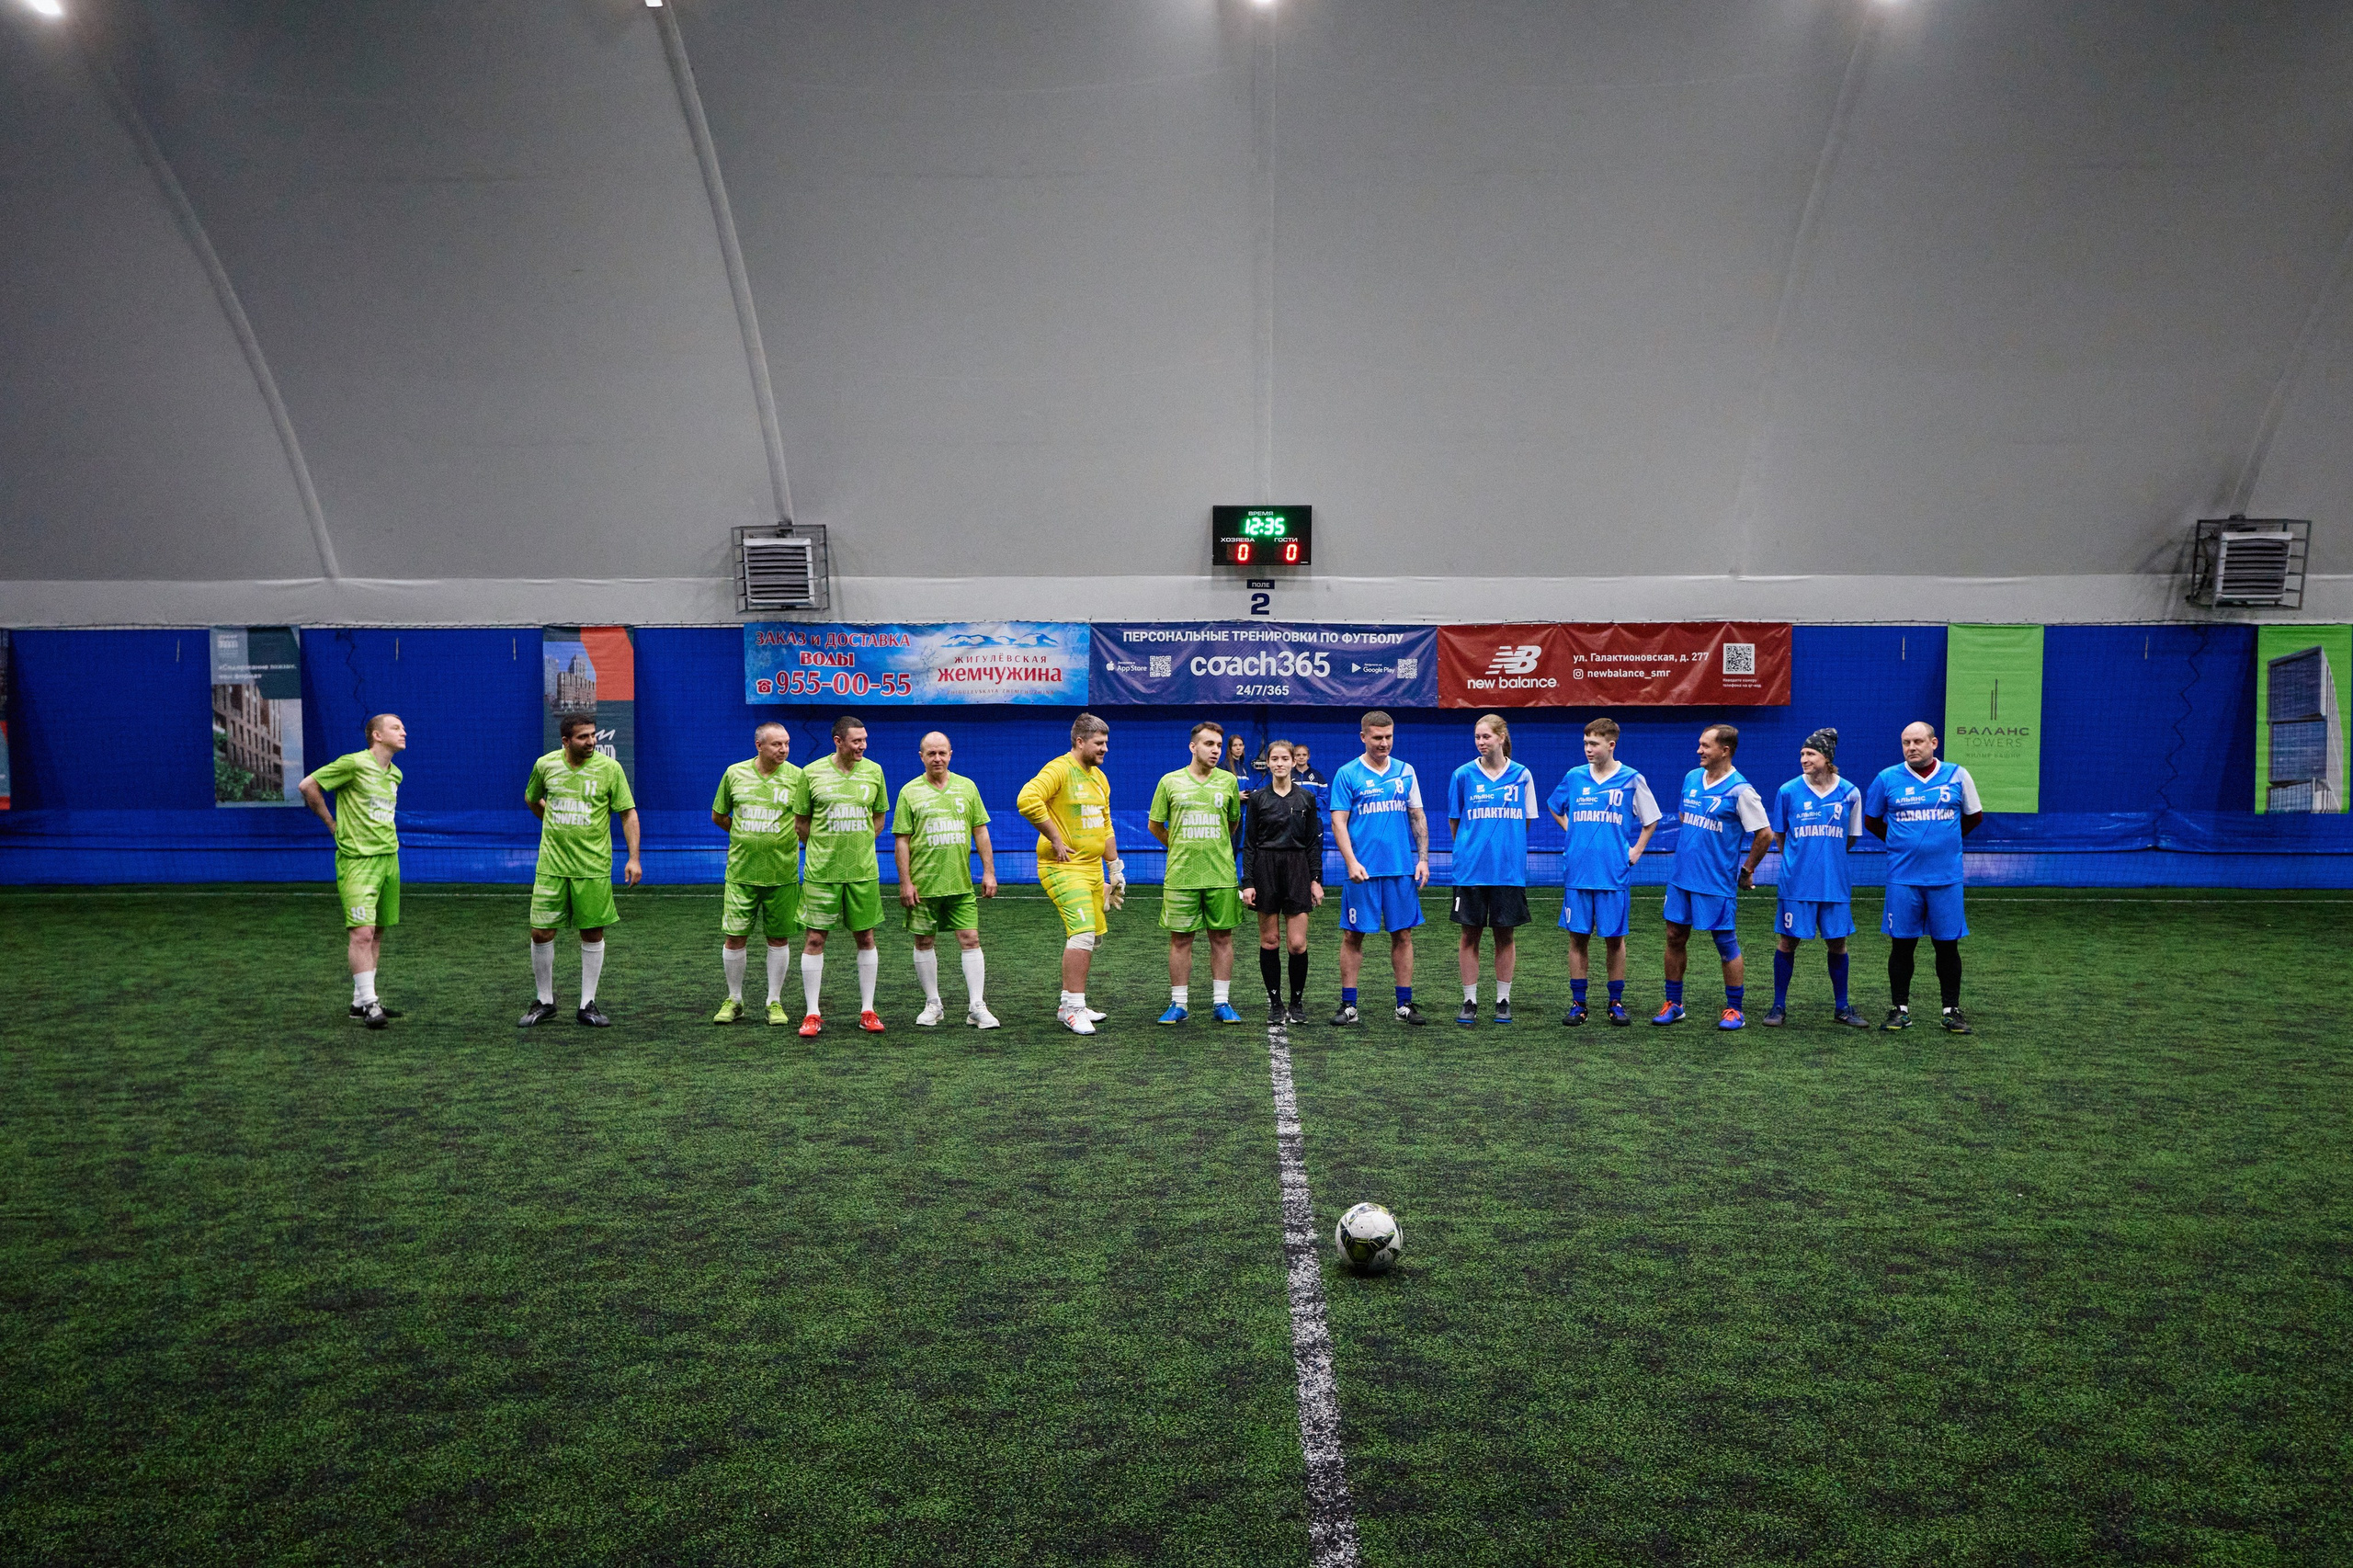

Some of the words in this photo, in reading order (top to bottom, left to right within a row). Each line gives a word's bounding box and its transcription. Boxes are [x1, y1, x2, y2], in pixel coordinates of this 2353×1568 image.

[1245, 517, 1286, 535] 12:35
[1237, 543, 1249, 562] 0
[1286, 543, 1297, 562] 0
[1250, 592, 1270, 616] 2
[756, 631, 807, 646] ЗАКАЗ
[824, 632, 911, 649] ДОСТАВКА
[1123, 631, 1229, 642] ПЕРСОНАЛЬНЫЕ
[1232, 631, 1317, 642] ТРЕНИРОВКИ
[1320, 632, 1338, 643] ПО
[1341, 632, 1404, 644] ФУТБОЛУ
[954, 653, 1047, 664] ЖИГУЛЁВСКАЯ
[1190, 651, 1330, 678] coach365
[1573, 654, 1588, 664] ул.
[1590, 653, 1678, 663] Галактионовская,
[1679, 654, 1689, 663] д.
[1691, 653, 1710, 662] 277
[938, 666, 1063, 685] жемчужина
[1363, 665, 1382, 674] Google
[1587, 668, 1671, 679] newbalance_smr
[776, 670, 913, 697] 955-00-55
[1467, 678, 1495, 689] new
[1498, 676, 1557, 689] balance
[1236, 685, 1290, 697] 24/7/365
[1957, 726, 2029, 736] БАЛАНС
[1964, 737, 2022, 748] TOWERS
[584, 779, 597, 797] 11
[859, 784, 870, 801] 7
[1394, 778, 1404, 794] 8
[1504, 785, 1518, 802] 21
[1939, 784, 1951, 803] 5
[773, 787, 790, 805] 14
[1214, 791, 1223, 809] 8
[1470, 793, 1495, 801] АЛЬЯНС
[1608, 790, 1624, 807] 10
[1895, 795, 1926, 804] АЛЬЯНС
[955, 797, 965, 814] 5
[1709, 796, 1722, 813] 7
[1834, 802, 1843, 821] 9
[551, 812, 592, 826] TOWERS
[1182, 813, 1221, 826] БАЛАНС
[1467, 807, 1523, 821] ГАЛАКТИКА
[741, 819, 781, 833] TOWERS
[827, 819, 868, 832] TOWERS
[926, 819, 965, 835] БАЛАНС
[1182, 826, 1221, 839] TOWERS
[926, 832, 966, 846] TOWERS
[1454, 896, 1461, 912] 1
[1076, 907, 1086, 922] 1
[1348, 907, 1358, 925] 8
[1784, 912, 1793, 929] 9
[1887, 912, 1893, 929] 5
